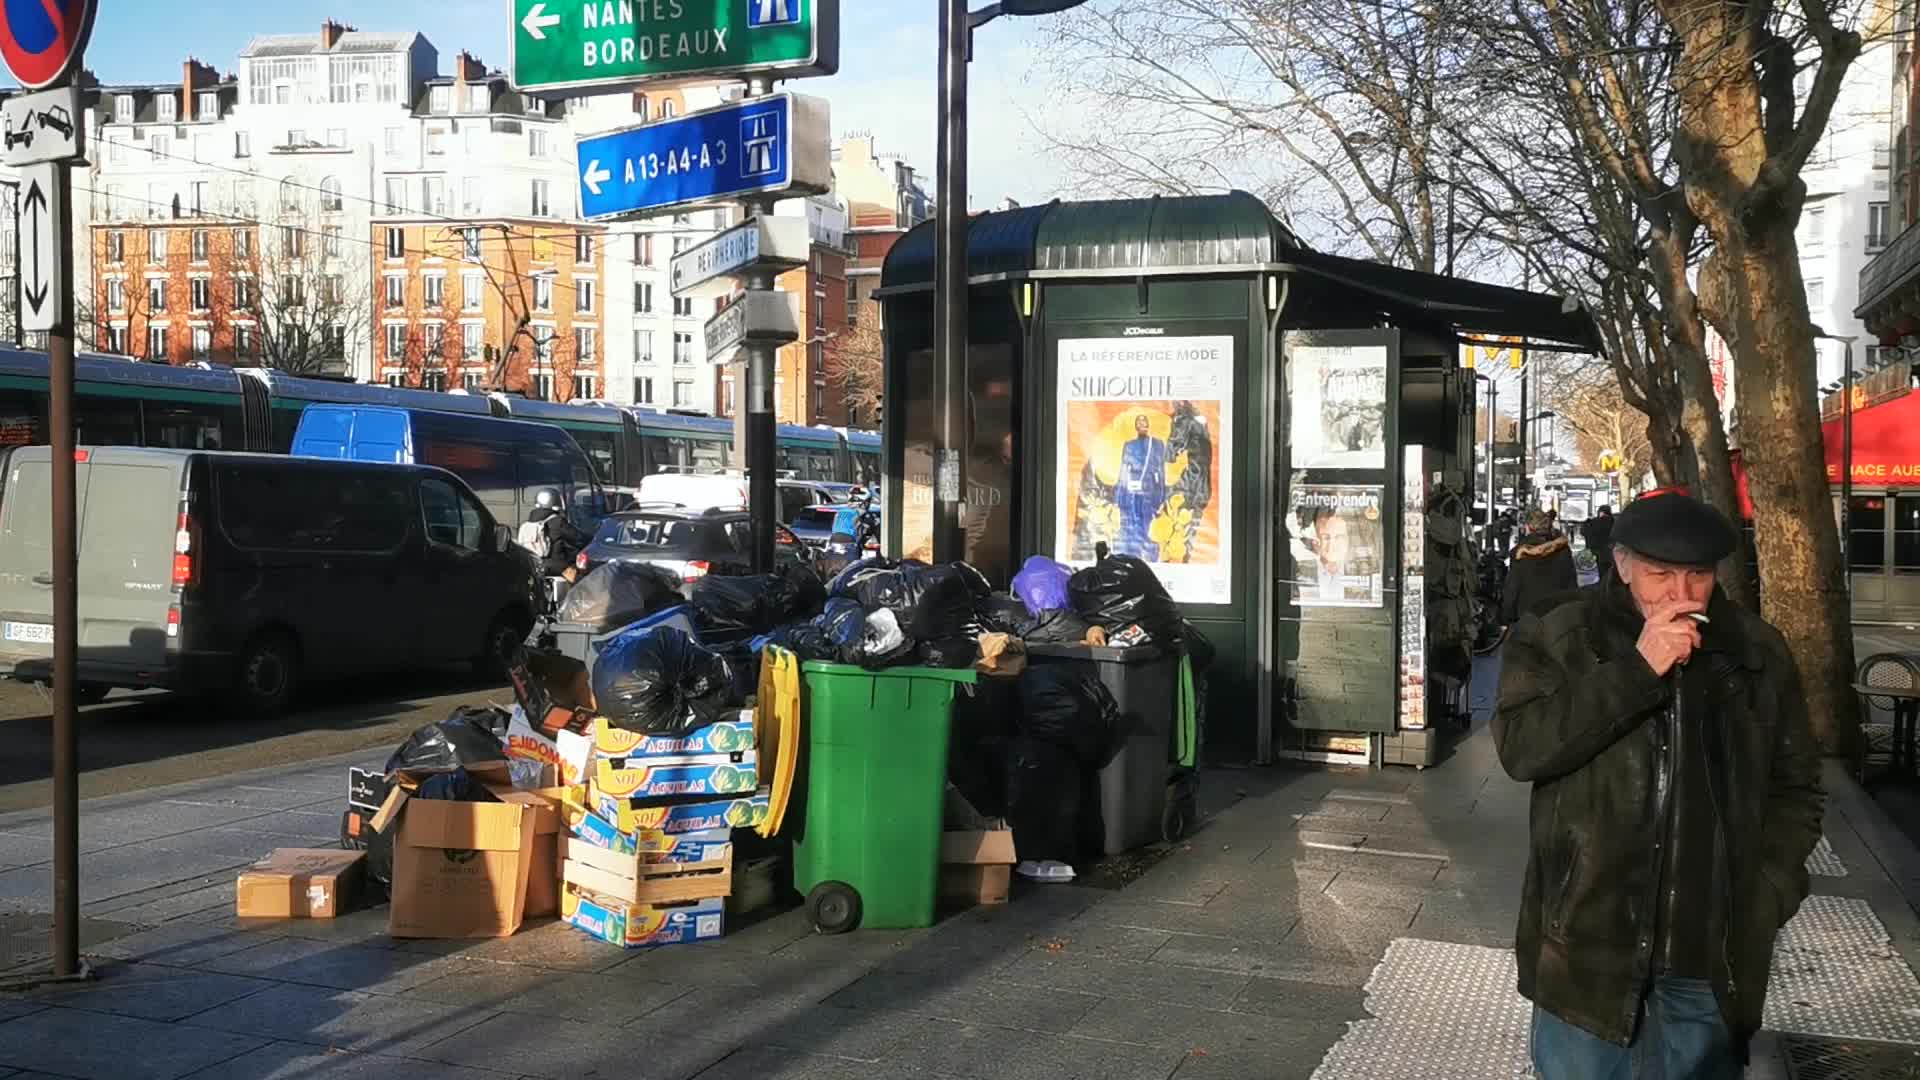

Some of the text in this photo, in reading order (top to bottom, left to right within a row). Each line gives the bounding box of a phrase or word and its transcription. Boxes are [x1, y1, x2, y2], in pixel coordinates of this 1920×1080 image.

[583, 0, 683, 28] NANTES
[583, 27, 728, 67] BORDEAUX
[1071, 351, 1088, 362] LA
[1177, 348, 1219, 361] MODE
[1602, 456, 1621, 471] M
